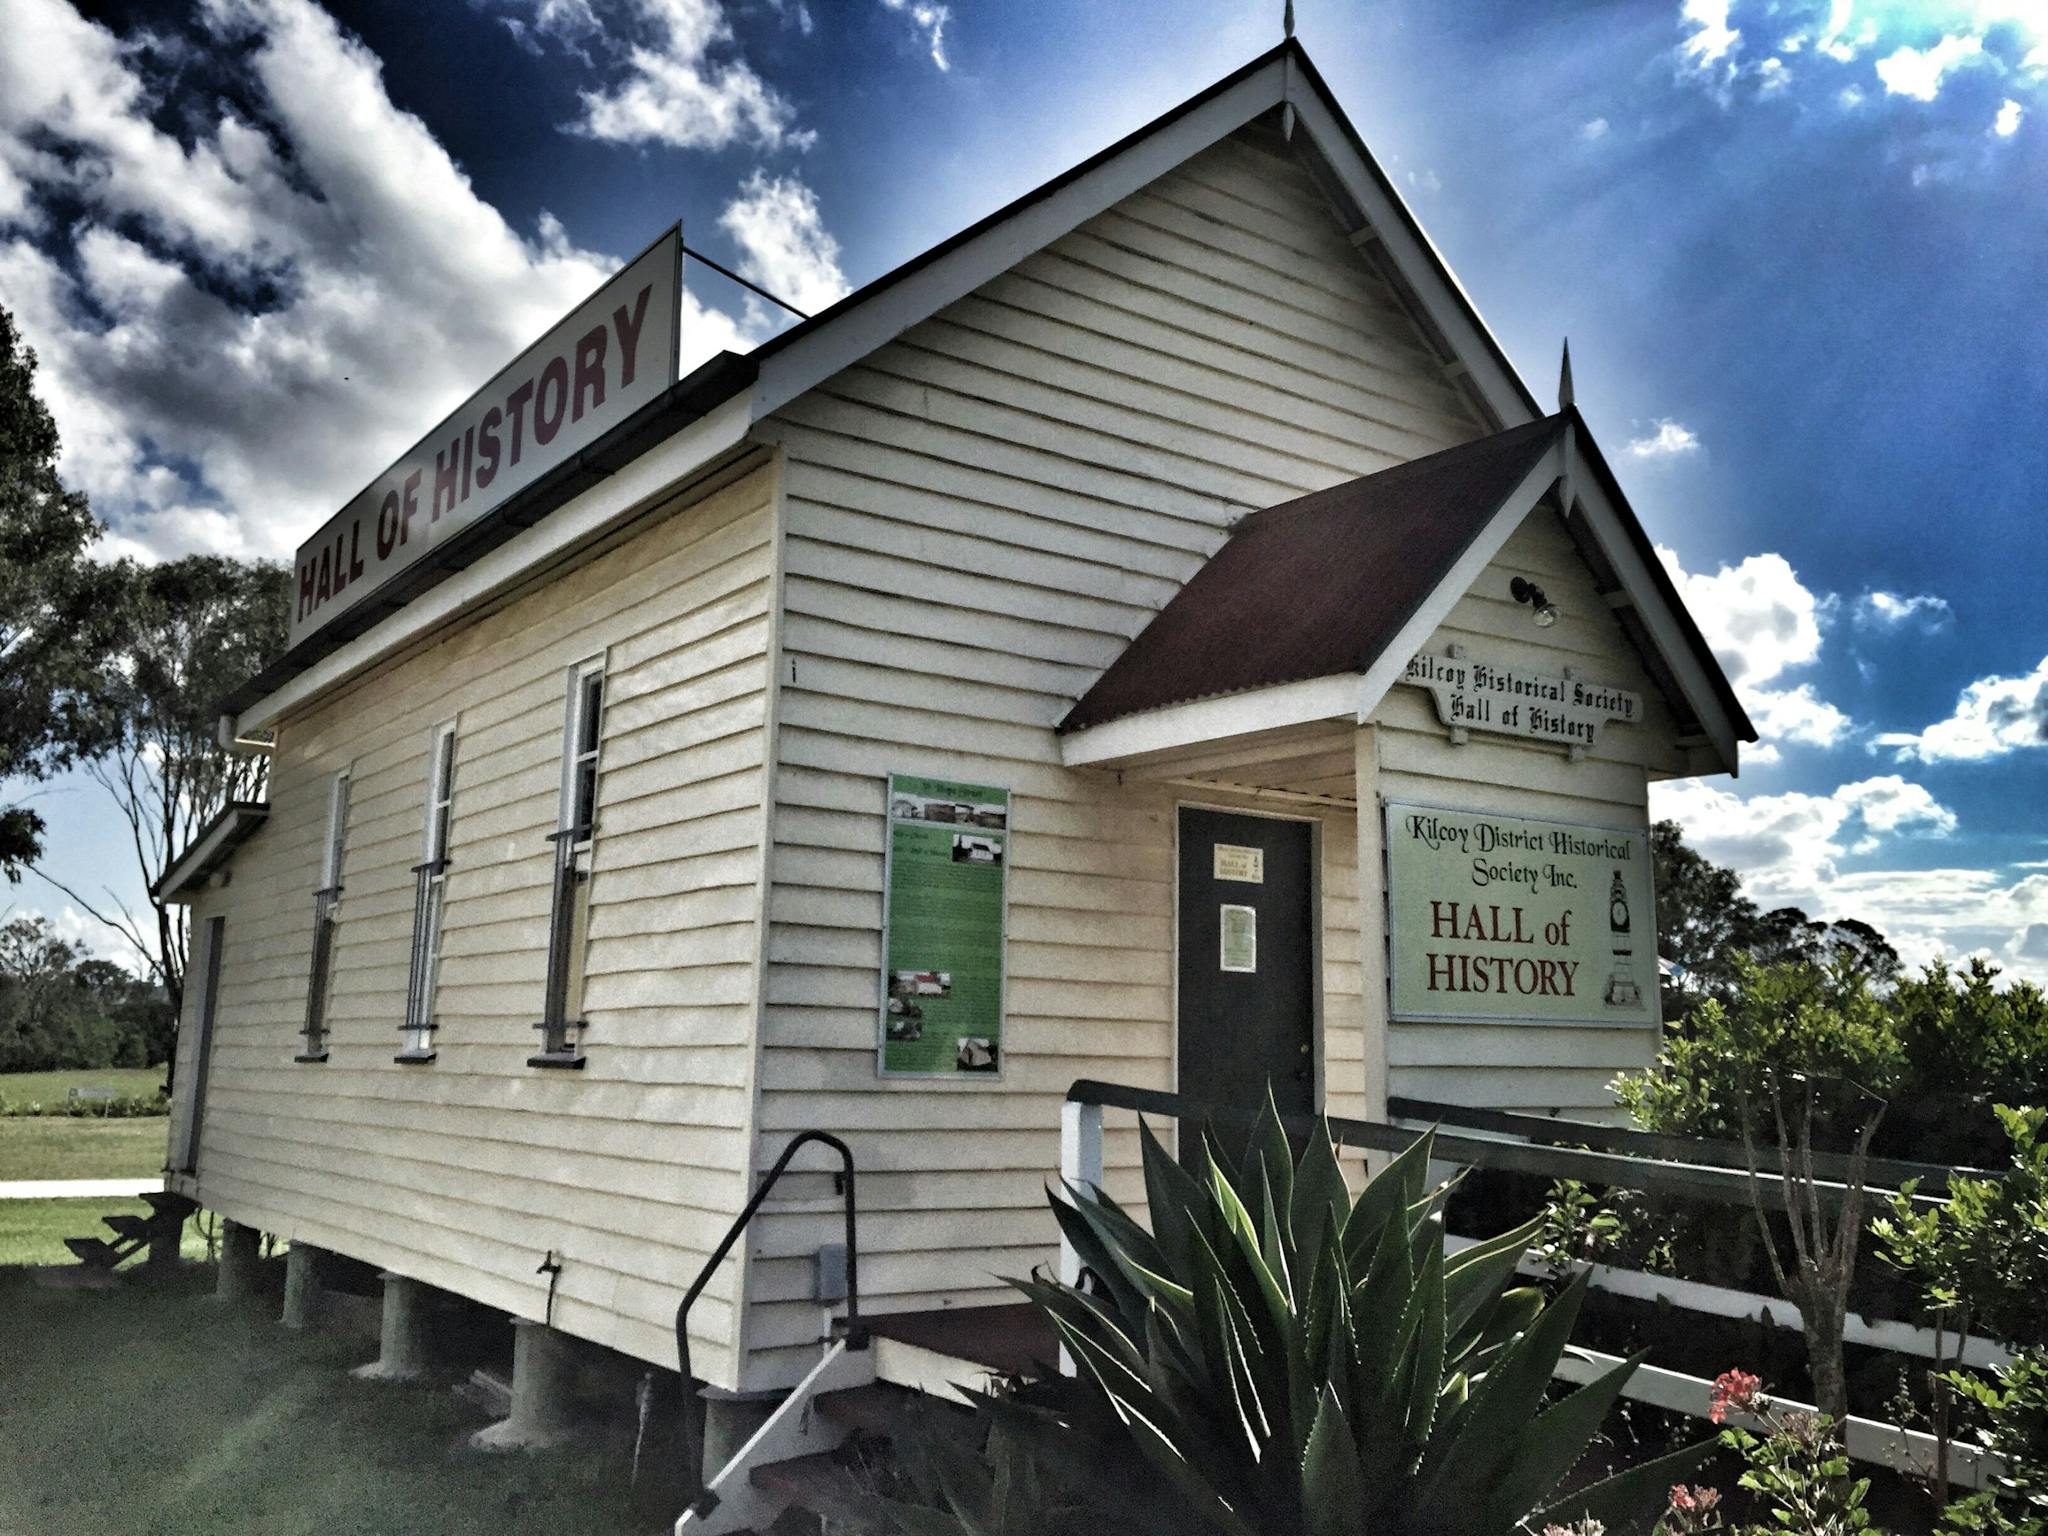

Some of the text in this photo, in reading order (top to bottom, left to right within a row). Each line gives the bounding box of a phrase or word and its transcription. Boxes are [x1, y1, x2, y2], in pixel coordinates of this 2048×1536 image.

[297, 283, 653, 624] HALL OF HISTORY
[1405, 655, 1633, 718] Kilcoy Historical Society
[1450, 694, 1595, 744] Hall of History
[1405, 815, 1631, 860] Kilcoy District Historical
[1472, 858, 1578, 894] Society Inc.
[1430, 900, 1572, 946] HALL of
[1426, 953, 1579, 996] HISTORY
